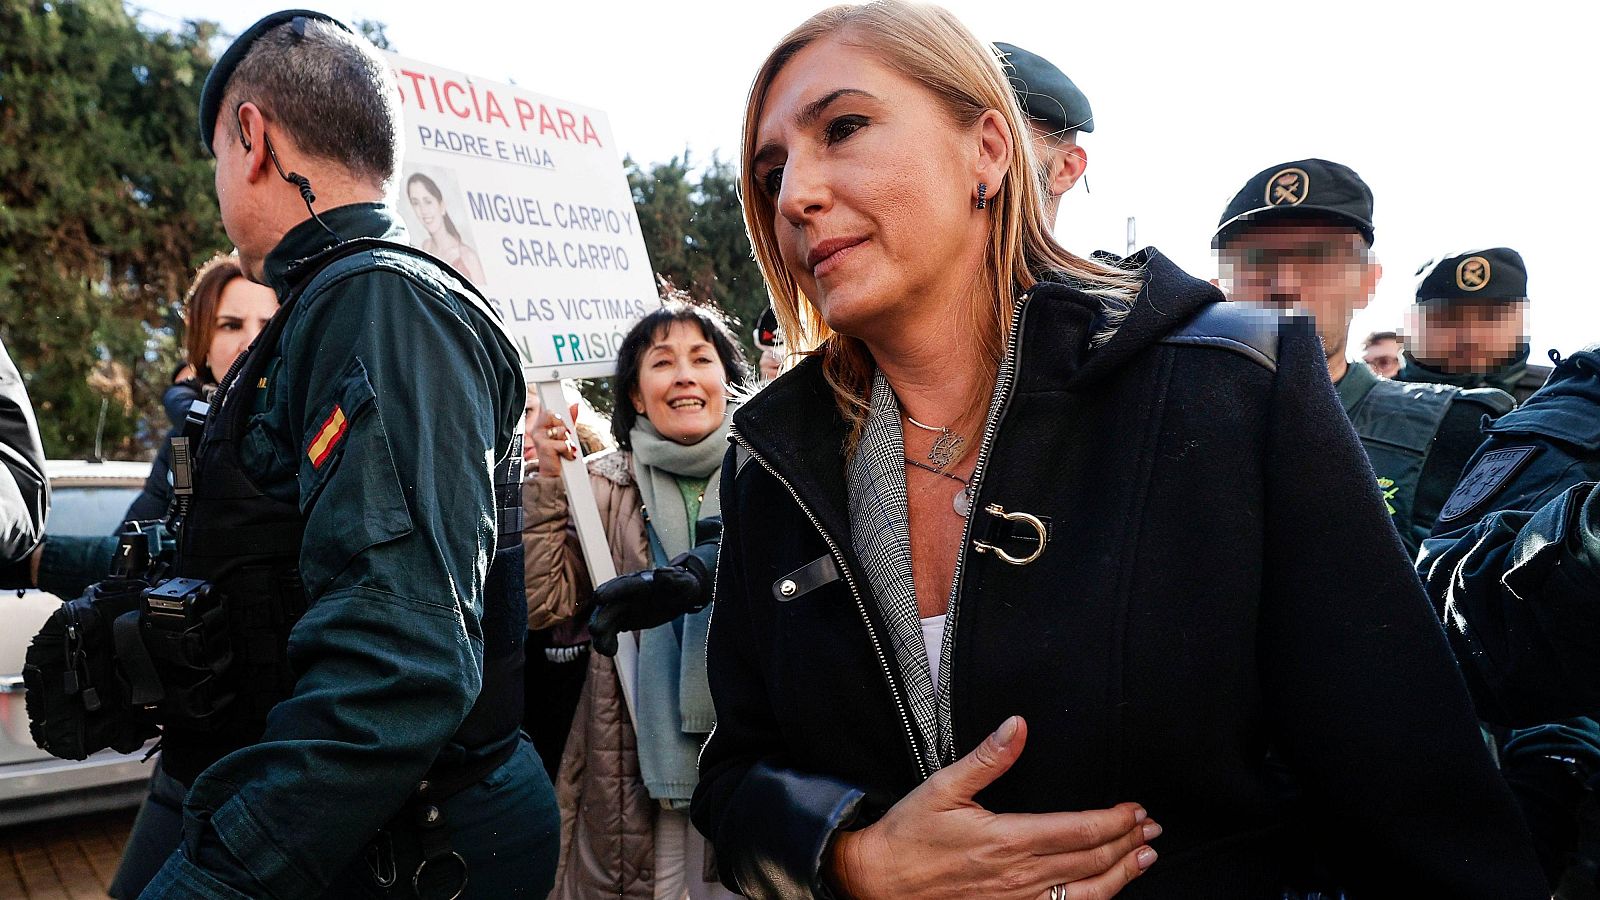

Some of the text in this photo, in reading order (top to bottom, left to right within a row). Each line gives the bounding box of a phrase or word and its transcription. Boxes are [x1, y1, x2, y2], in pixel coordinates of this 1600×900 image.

[513, 96, 603, 148] PARA
[417, 125, 556, 168] PADRE E HIJA
[466, 190, 634, 236] MIGUEL CARPIO Y
[501, 236, 630, 272] SARA CARPIO
[509, 298, 555, 322] LAS
[557, 298, 647, 321] VICTIMAS
[122, 544, 132, 556] 7
